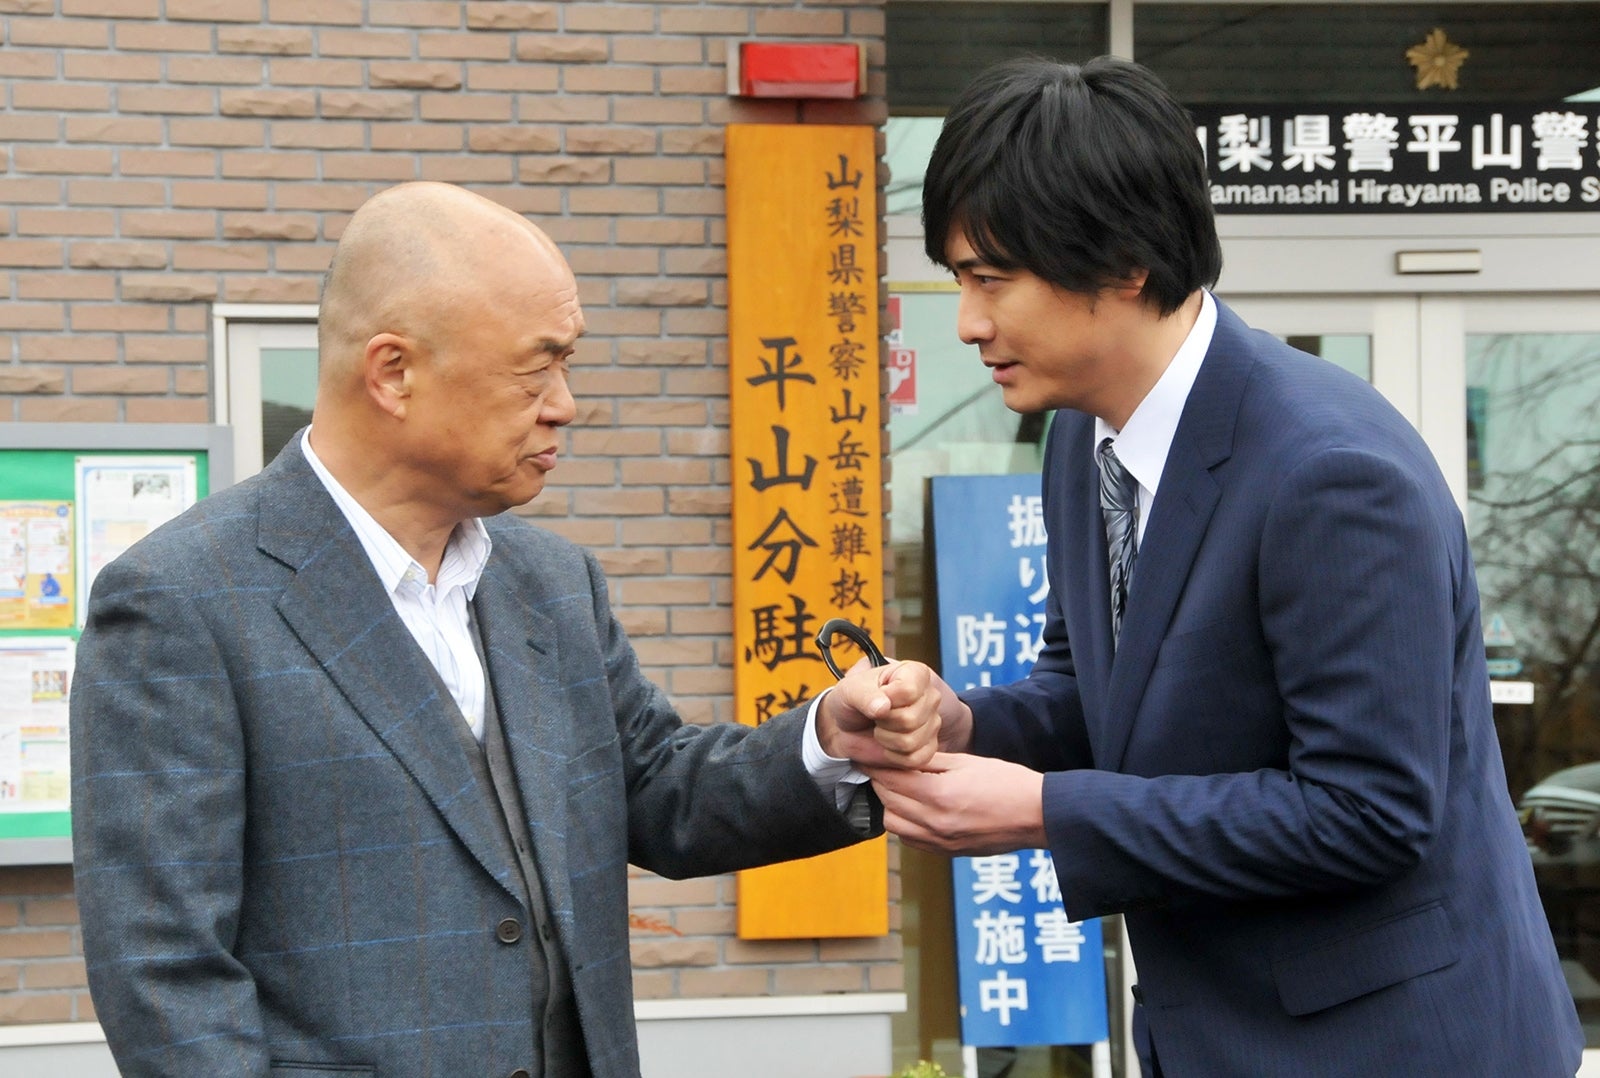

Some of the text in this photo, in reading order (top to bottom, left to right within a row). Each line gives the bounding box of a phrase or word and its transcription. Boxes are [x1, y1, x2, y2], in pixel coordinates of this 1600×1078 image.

[1196, 111, 1600, 173] 梨県警平山警
[1208, 176, 1600, 207] amanashi Hirayama Police S
[825, 154, 871, 675] 山梨県警察山岳遭難救
